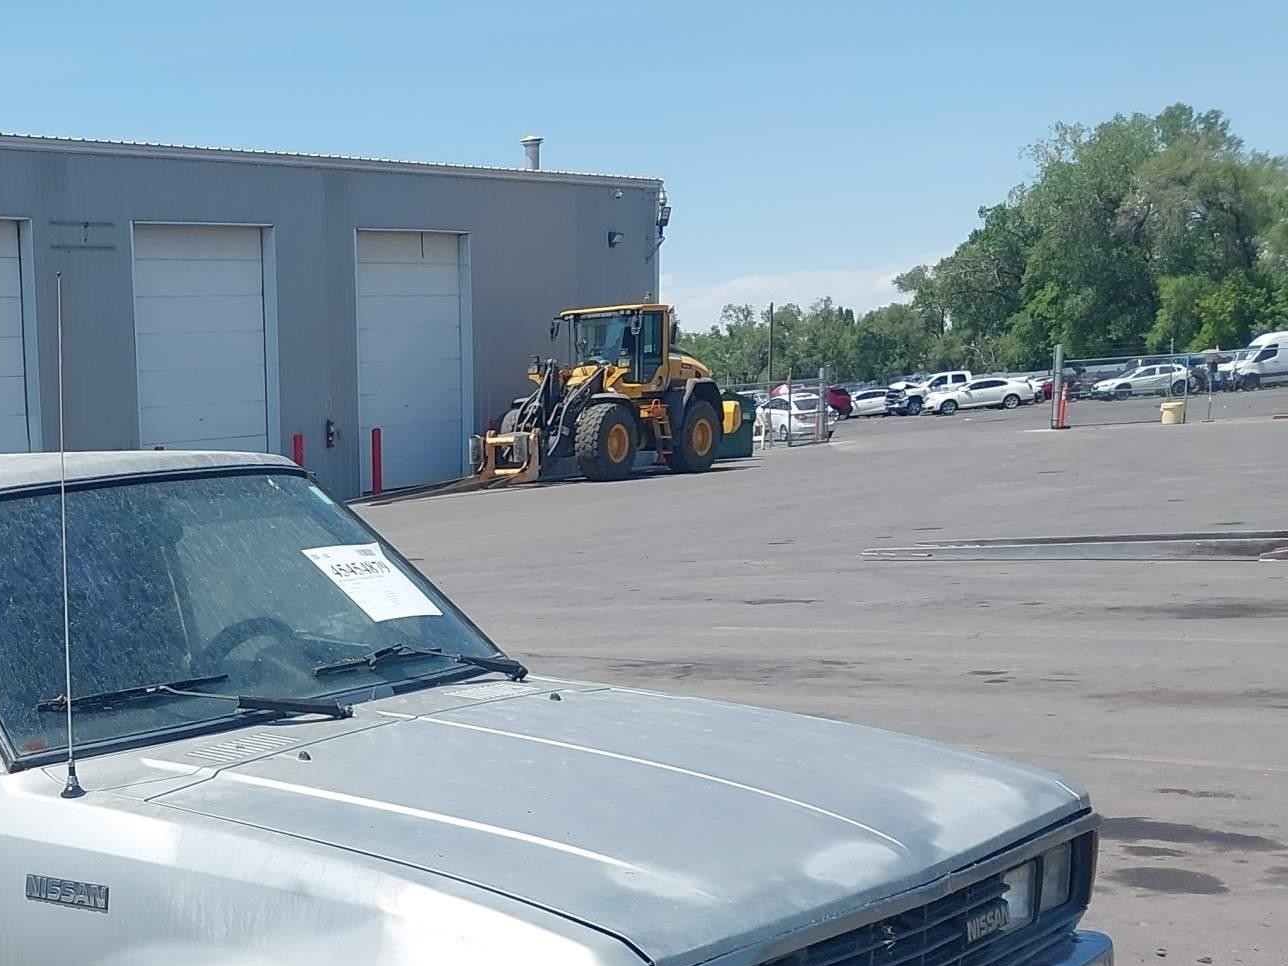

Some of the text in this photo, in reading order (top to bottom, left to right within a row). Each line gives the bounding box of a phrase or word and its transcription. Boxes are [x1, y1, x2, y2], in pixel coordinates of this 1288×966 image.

[331, 561, 390, 577] 45454879
[26, 875, 107, 908] NISSAN
[967, 906, 1009, 941] NISSAN
